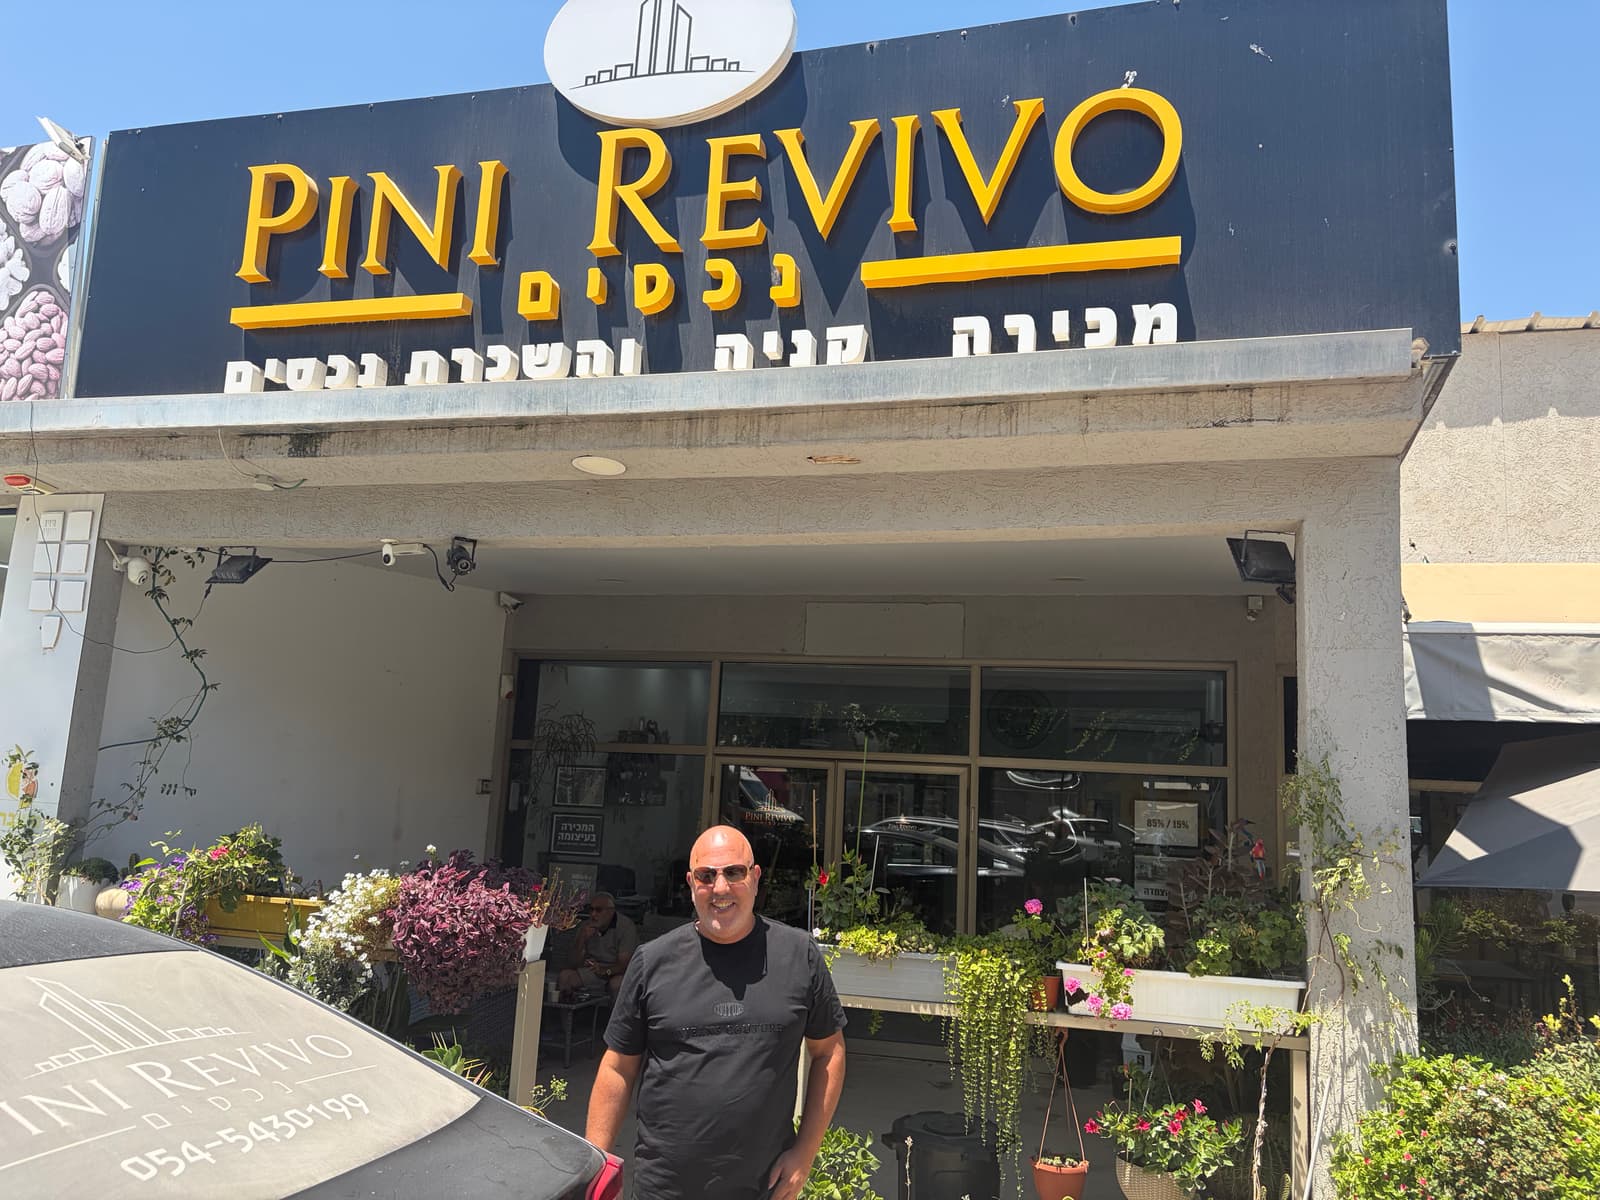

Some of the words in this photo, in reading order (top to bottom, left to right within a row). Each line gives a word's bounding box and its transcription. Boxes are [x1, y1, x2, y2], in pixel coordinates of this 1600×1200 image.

[235, 160, 510, 284] PINI
[586, 87, 1184, 258] REVIVO
[518, 253, 801, 321] נכסים
[714, 324, 869, 370] קניה
[952, 301, 1178, 358] מכירה
[223, 352, 388, 395] נכסים
[404, 338, 642, 387] והשכרת
[557, 832, 597, 842] בעיצומה
[561, 823, 595, 832] המכירה
[1146, 818, 1165, 828] 85%
[1173, 819, 1190, 829] 15%
[125, 1034, 354, 1099] REVIVO
[141, 1080, 293, 1131] נכסים
[120, 1092, 370, 1181] 054-5430199
